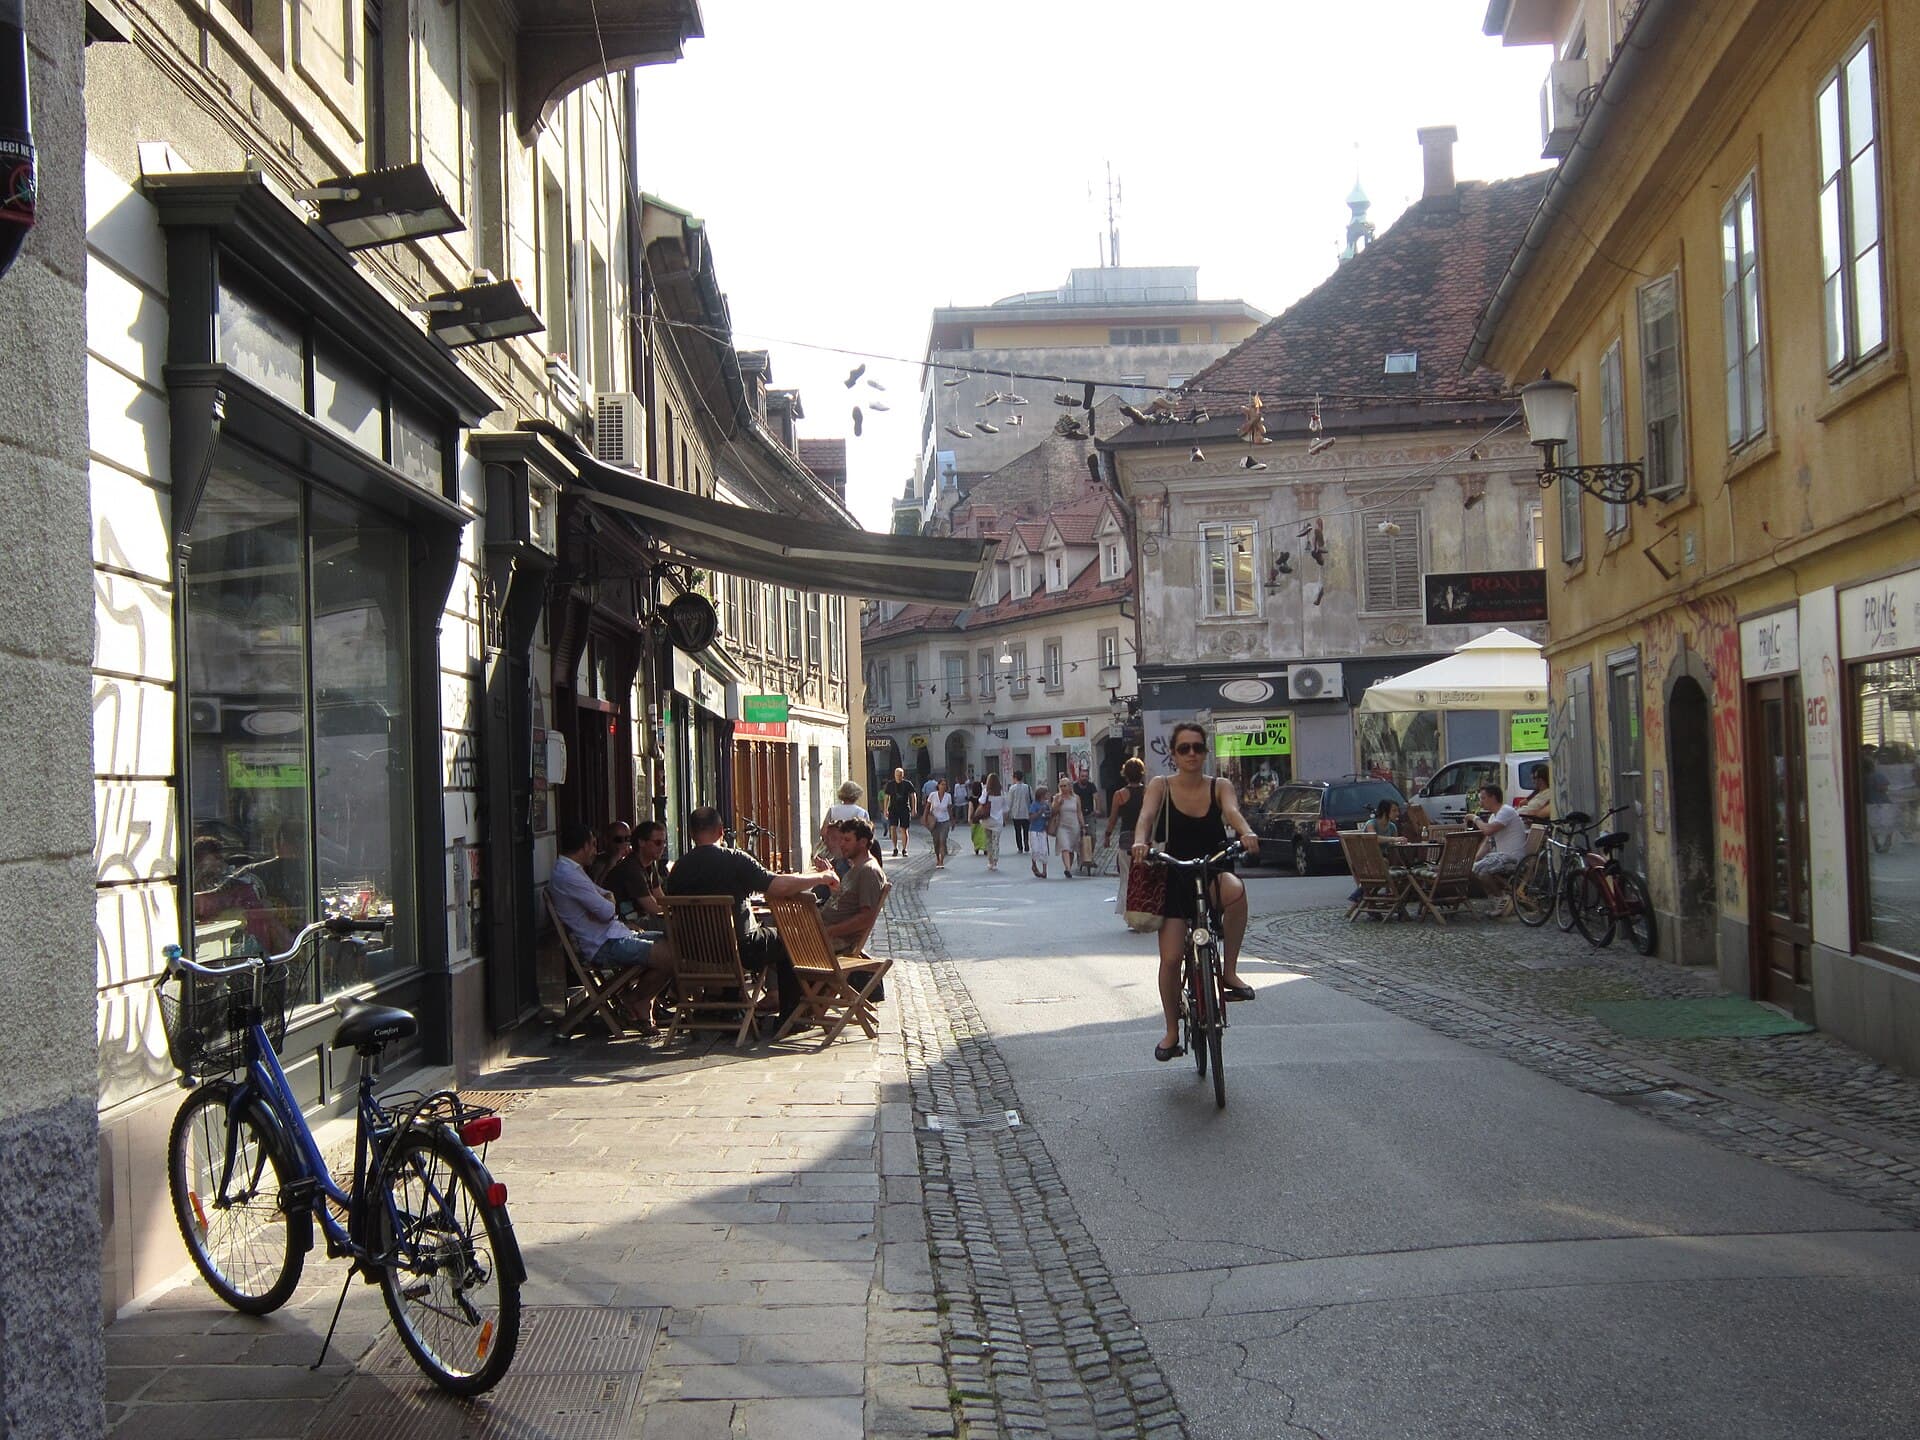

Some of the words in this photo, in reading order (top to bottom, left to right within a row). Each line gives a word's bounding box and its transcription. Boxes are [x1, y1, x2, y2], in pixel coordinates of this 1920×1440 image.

[20, 144, 30, 157] NE
[1807, 696, 1828, 726] ara
[871, 716, 896, 724] FRIZER
[867, 739, 891, 747] FRIZER
[374, 1027, 399, 1037] Comfort
